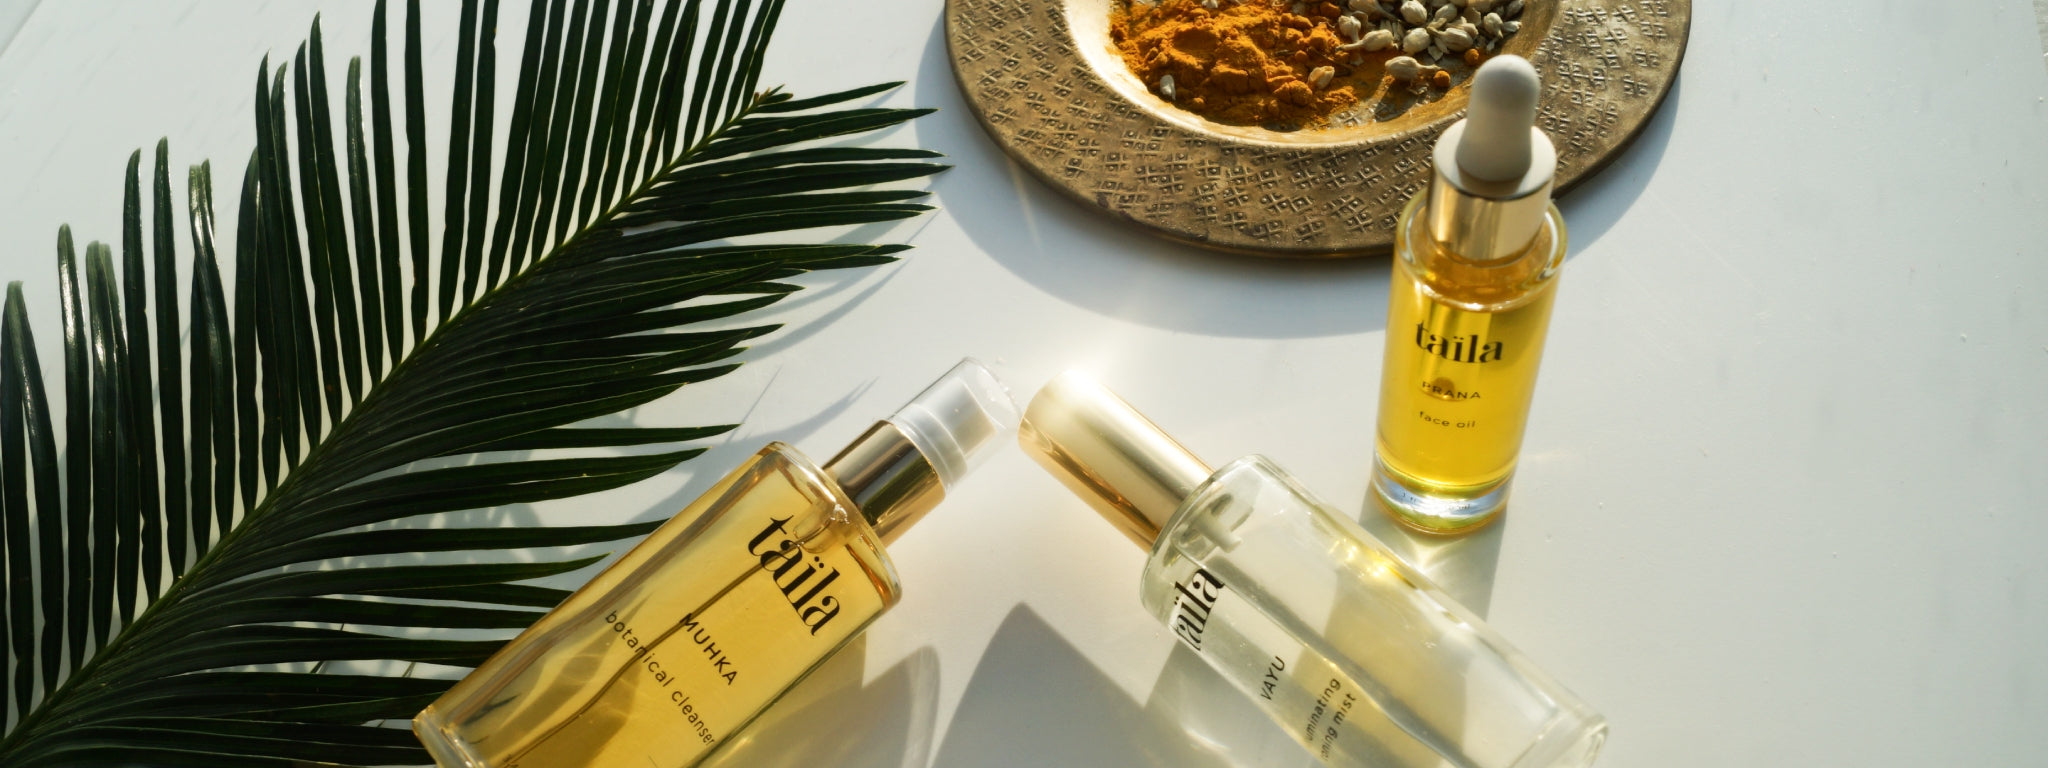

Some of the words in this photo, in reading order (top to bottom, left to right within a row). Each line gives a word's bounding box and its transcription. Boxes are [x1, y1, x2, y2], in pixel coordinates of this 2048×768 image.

[1416, 320, 1504, 364] taïla
[1422, 381, 1481, 399] PRANA
[1419, 410, 1450, 427] face
[1456, 420, 1476, 428] oil
[748, 515, 840, 636] taïla
[679, 613, 738, 686] MUHKA
[604, 610, 675, 688] botanical
[671, 689, 716, 746] cleanser
[1260, 656, 1286, 701] VAYU
[1333, 693, 1356, 726] mist
